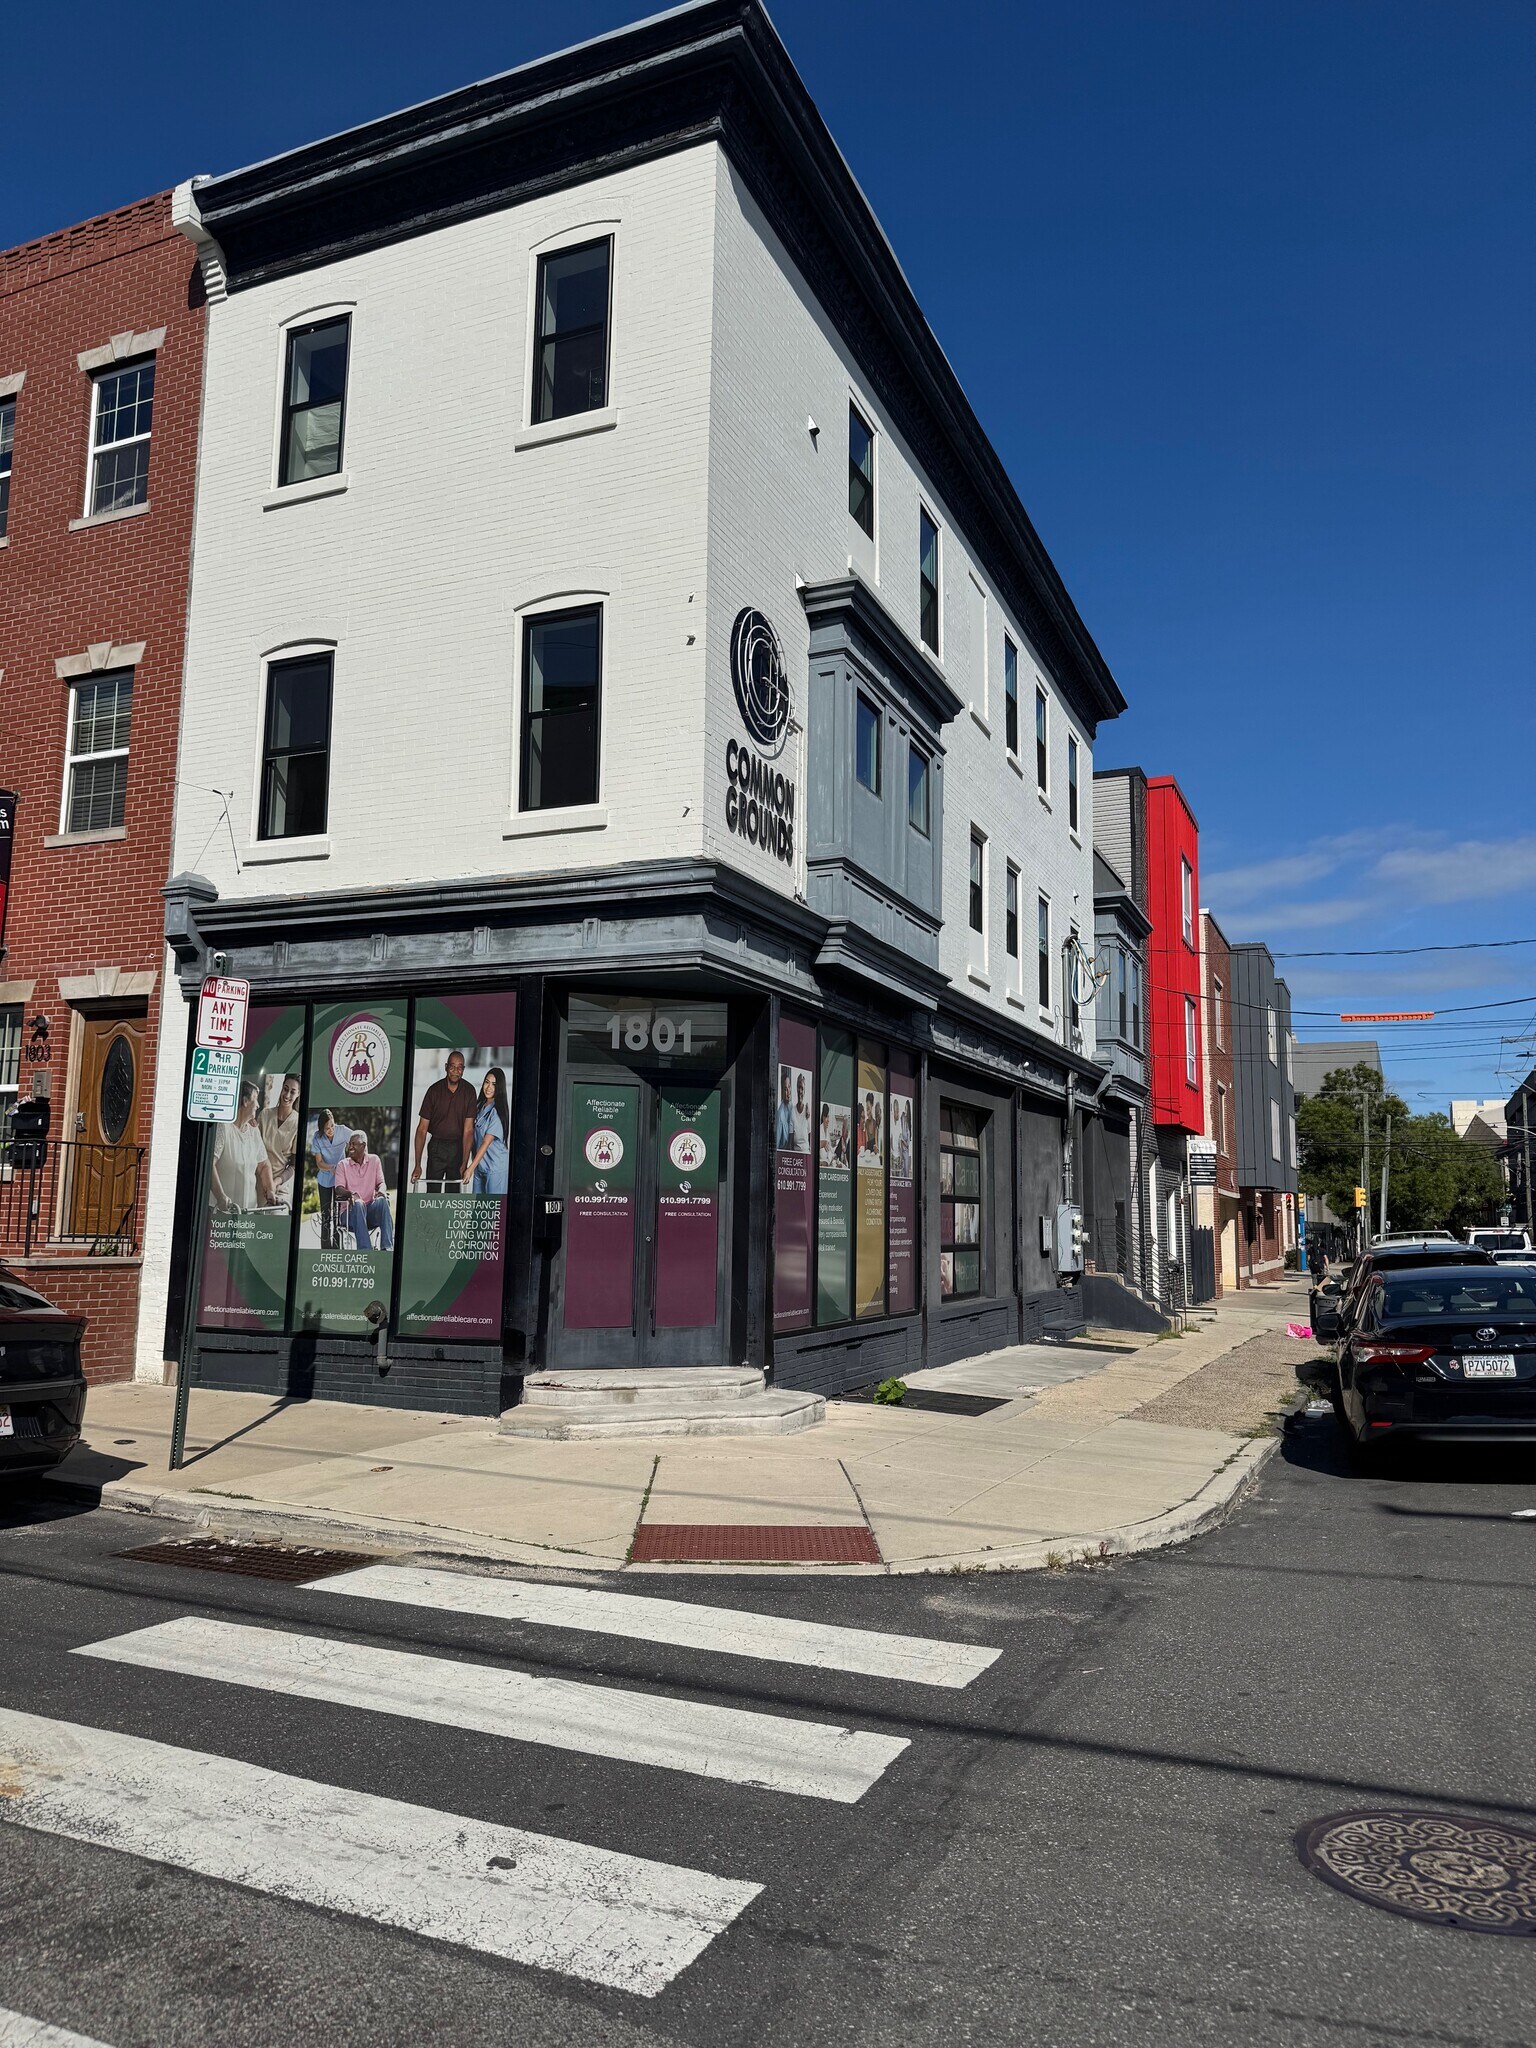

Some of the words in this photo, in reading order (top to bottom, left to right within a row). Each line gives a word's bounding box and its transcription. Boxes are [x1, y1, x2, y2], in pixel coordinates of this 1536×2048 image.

[726, 739, 794, 824] COMMON
[726, 786, 793, 867] GROUNDS
[203, 980, 216, 994] NO
[218, 983, 246, 996] PARKING
[212, 1001, 235, 1016] ANY
[210, 1016, 234, 1032] TIME
[606, 1014, 692, 1054] 1801
[25, 1045, 51, 1062] 1803
[196, 1052, 206, 1071] 2
[218, 1053, 232, 1064] HR
[208, 1063, 239, 1076] PARKING
[213, 1095, 218, 1104] 9
[586, 1099, 625, 1107] Affectionate
[592, 1105, 619, 1113] Reliable
[781, 1156, 792, 1166] FREE
[954, 1161, 979, 1194] Caring
[420, 1199, 444, 1209] DAILY
[445, 1200, 501, 1210] ASSISTANCE
[574, 1195, 628, 1204] 610.991.7799
[660, 1196, 711, 1205] 610.991.7799
[546, 1201, 562, 1213] 1801
[453, 1210, 473, 1219] FOR
[474, 1210, 501, 1220] YOUR
[210, 1219, 227, 1228] Your
[227, 1220, 256, 1229] Reliable
[448, 1220, 479, 1230] LOVED
[480, 1220, 500, 1230] ONE
[209, 1229, 231, 1239] Home
[231, 1230, 255, 1239] Health
[256, 1231, 274, 1240] Care
[445, 1230, 475, 1240] LIVING
[476, 1230, 500, 1240] WITH
[209, 1239, 246, 1250] Specialists
[449, 1240, 456, 1250] A
[457, 1240, 500, 1251] CHRONIC
[320, 1253, 343, 1263] FREE
[344, 1253, 368, 1264] CARE
[448, 1250, 499, 1261] CONDITION
[311, 1263, 376, 1274] CONSULTATION
[311, 1276, 375, 1289] 610.991.7799
[203, 1304, 280, 1317] affectionatereliablecare.com
[406, 1313, 493, 1324] affectionatereliablecare.com
[1468, 1360, 1510, 1372] PZV5072
